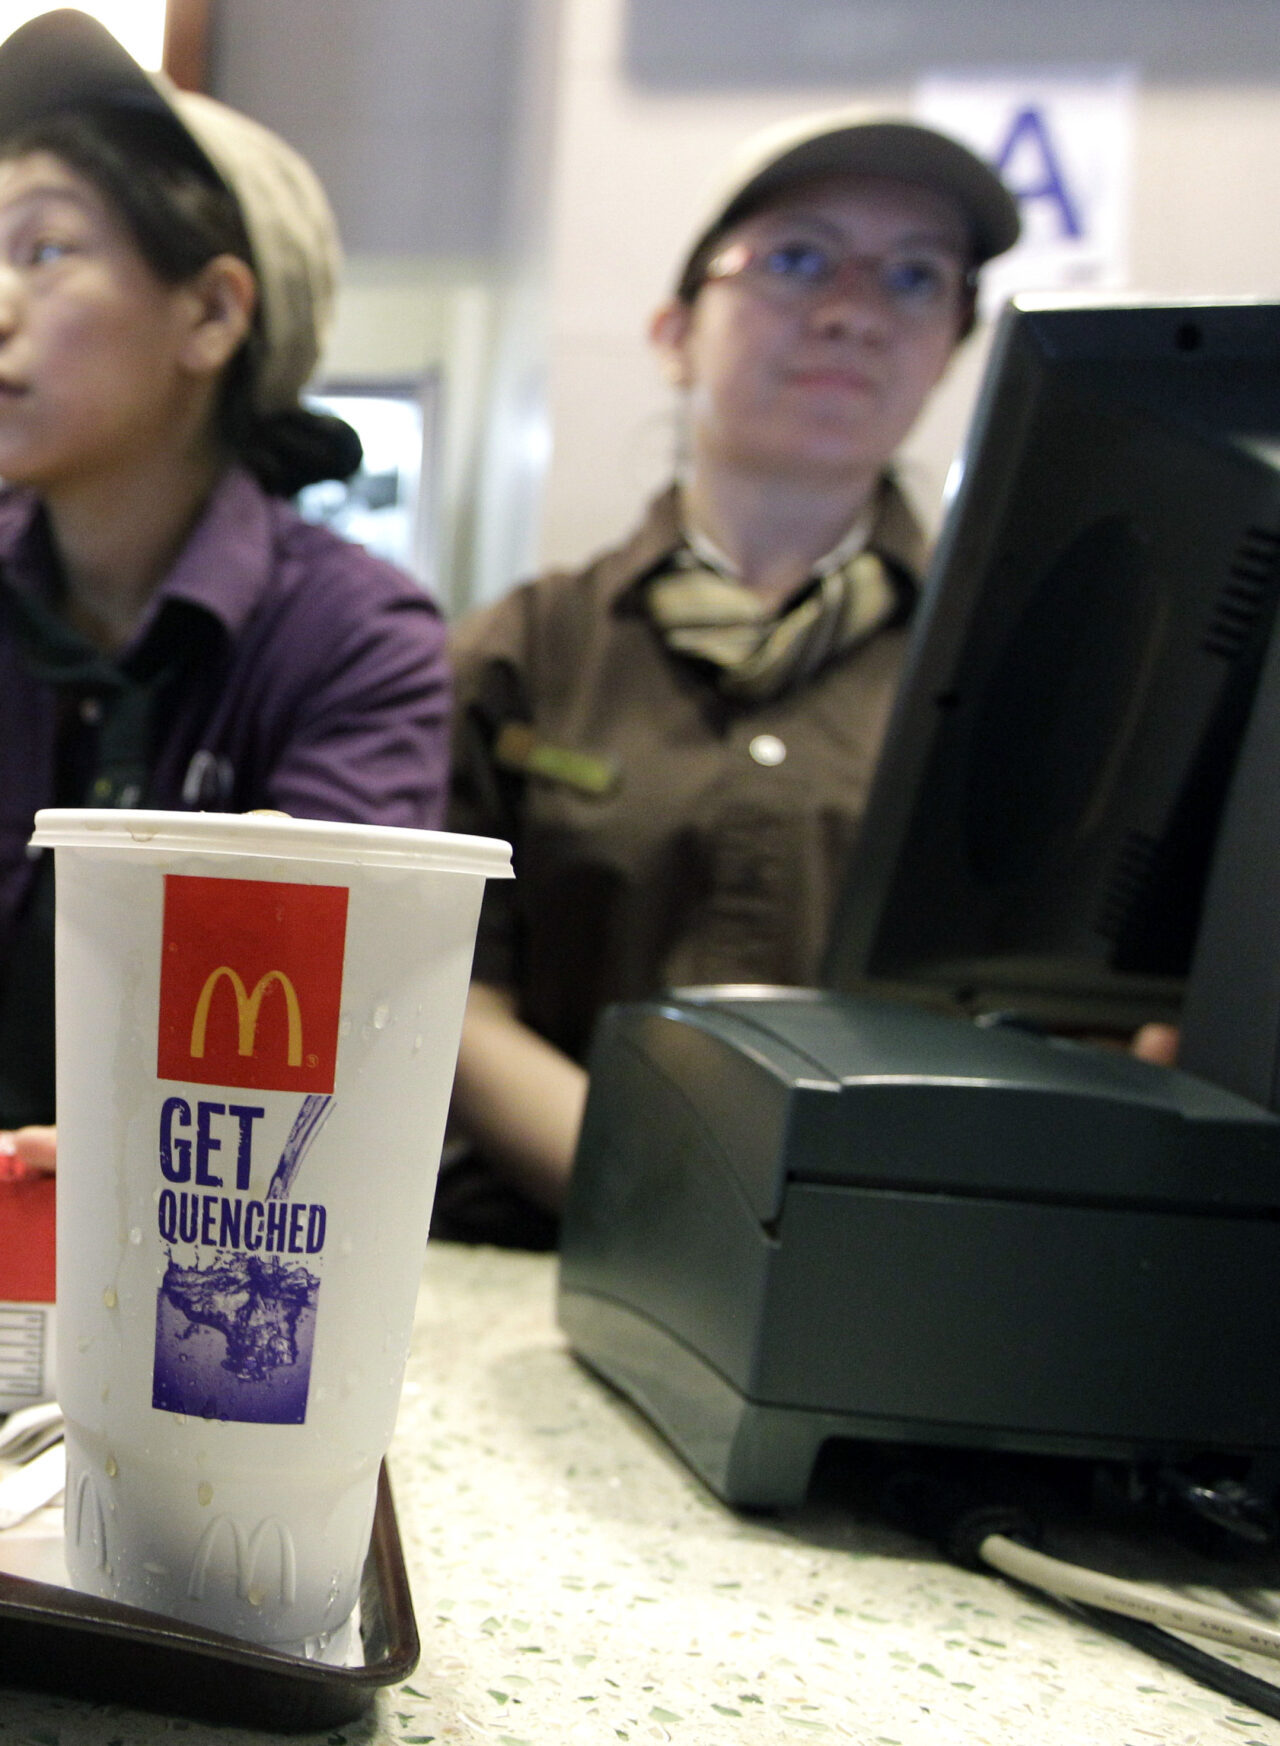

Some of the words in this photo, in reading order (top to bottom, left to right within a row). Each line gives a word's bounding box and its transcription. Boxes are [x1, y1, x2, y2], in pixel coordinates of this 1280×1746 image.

[994, 110, 1083, 237] A
[159, 1097, 265, 1190] GET
[158, 1189, 327, 1254] QUENCHED
